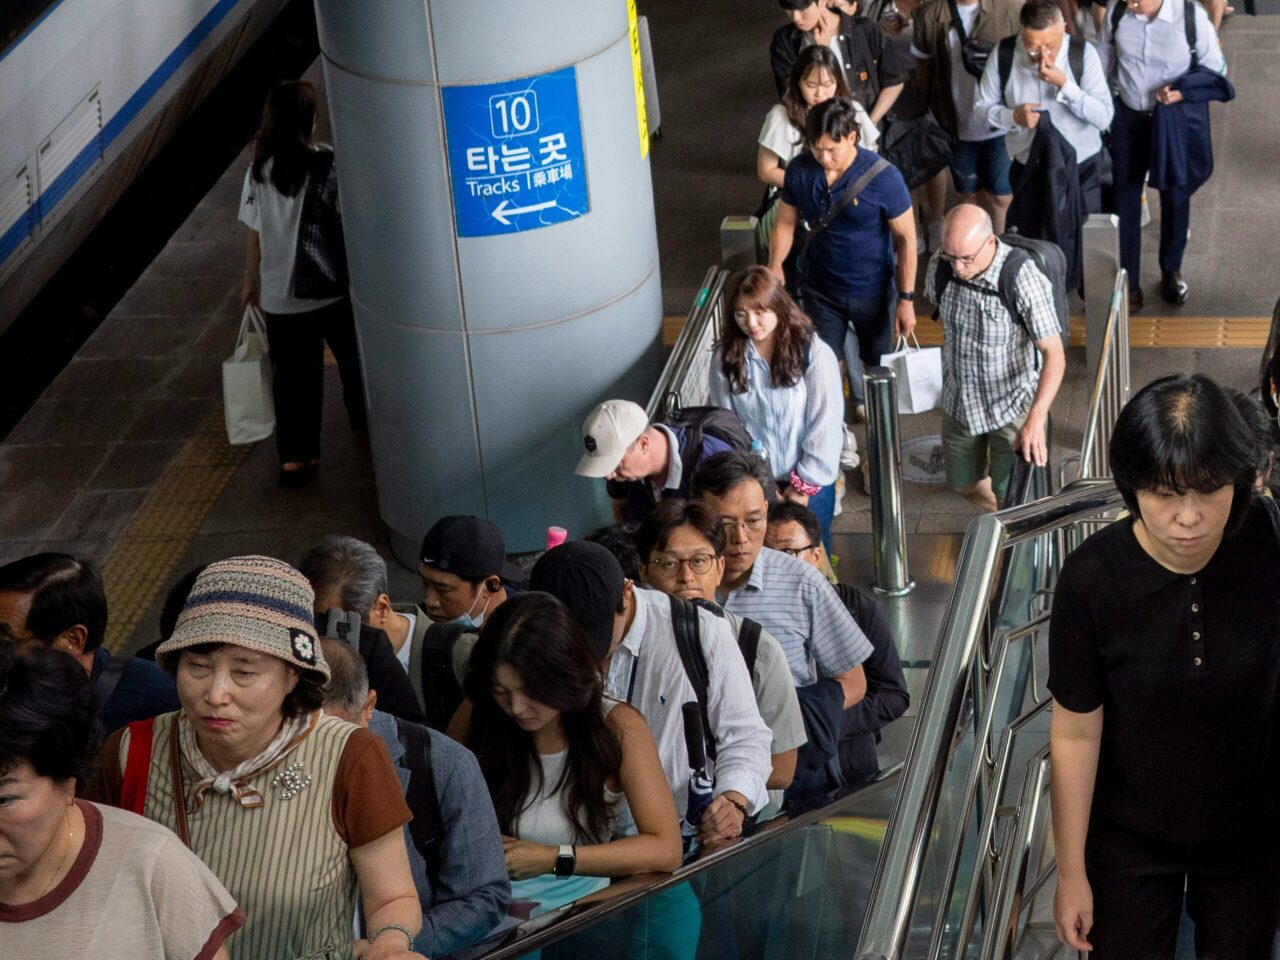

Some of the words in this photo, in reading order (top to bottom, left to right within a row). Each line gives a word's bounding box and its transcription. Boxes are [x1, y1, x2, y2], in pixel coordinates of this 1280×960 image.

[495, 96, 531, 133] 10
[466, 144, 531, 174] 타는
[539, 132, 567, 165] 곳
[466, 177, 520, 197] Tracks
